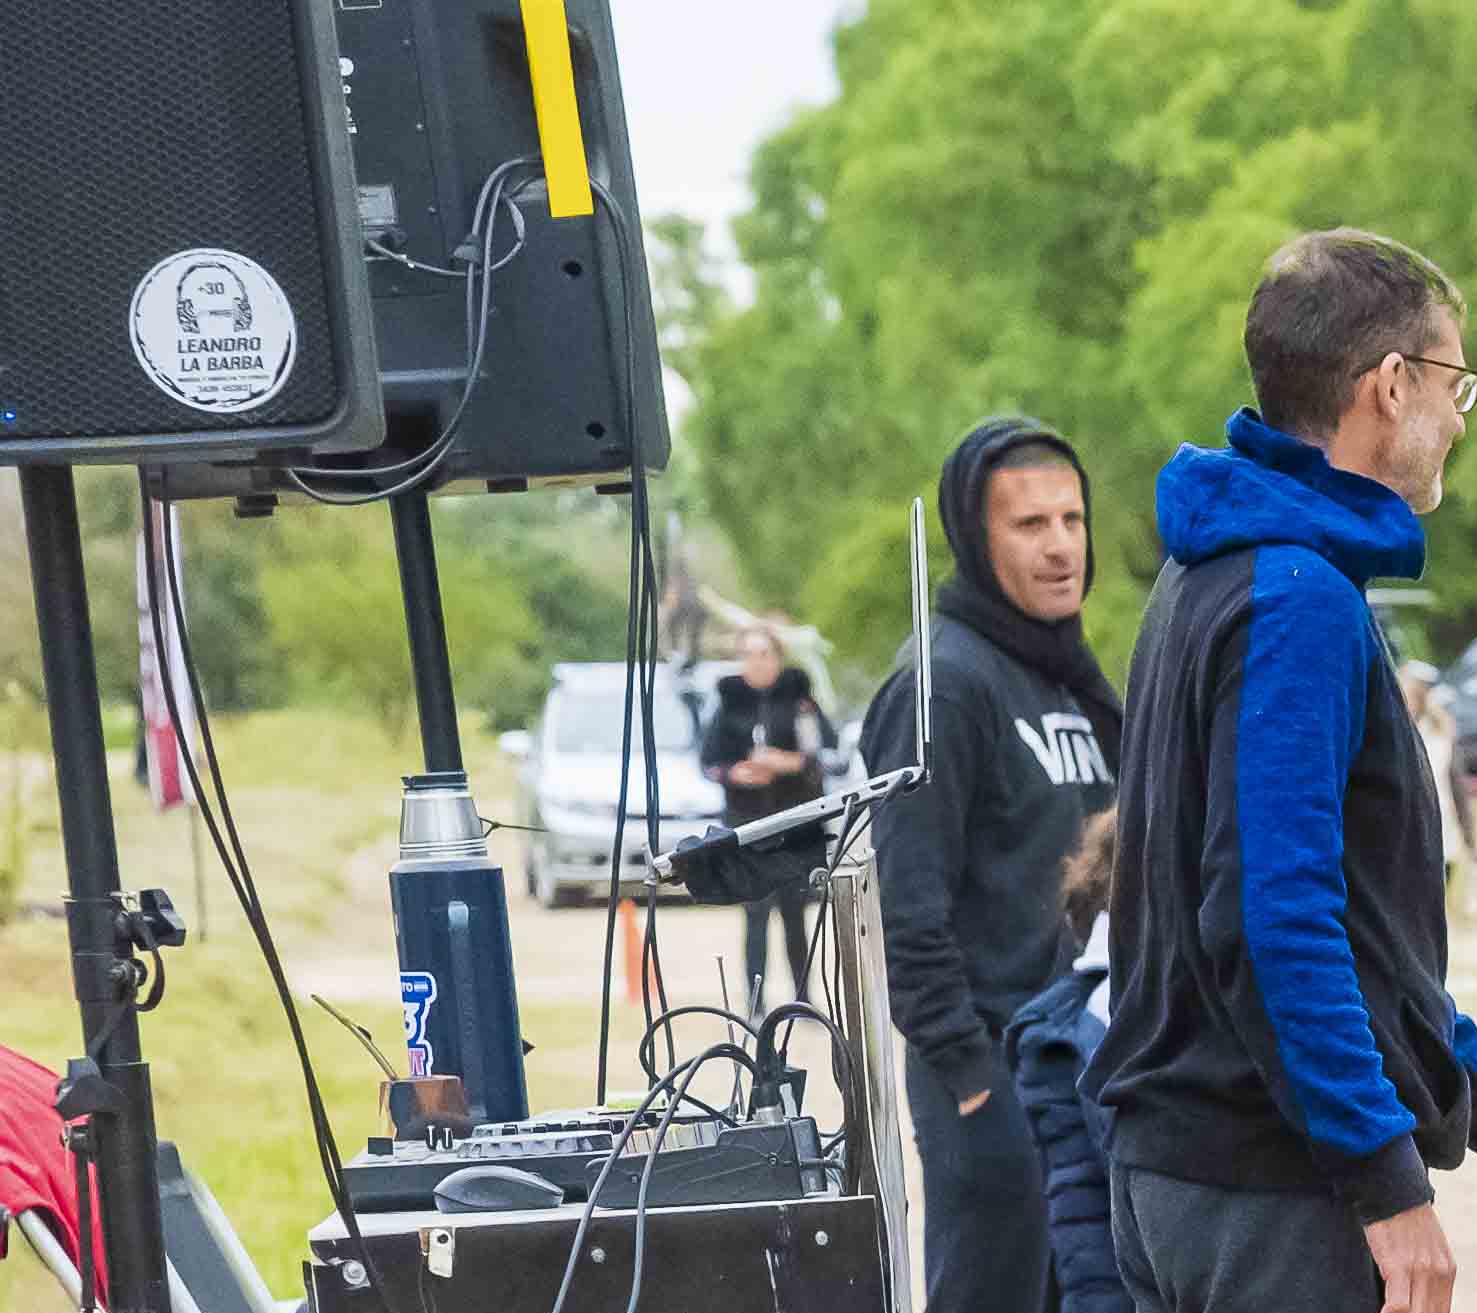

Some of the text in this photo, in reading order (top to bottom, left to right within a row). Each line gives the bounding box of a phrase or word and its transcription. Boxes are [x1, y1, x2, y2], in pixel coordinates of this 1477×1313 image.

[177, 336, 262, 354] LEANDRO
[180, 354, 265, 372] LA BARBA
